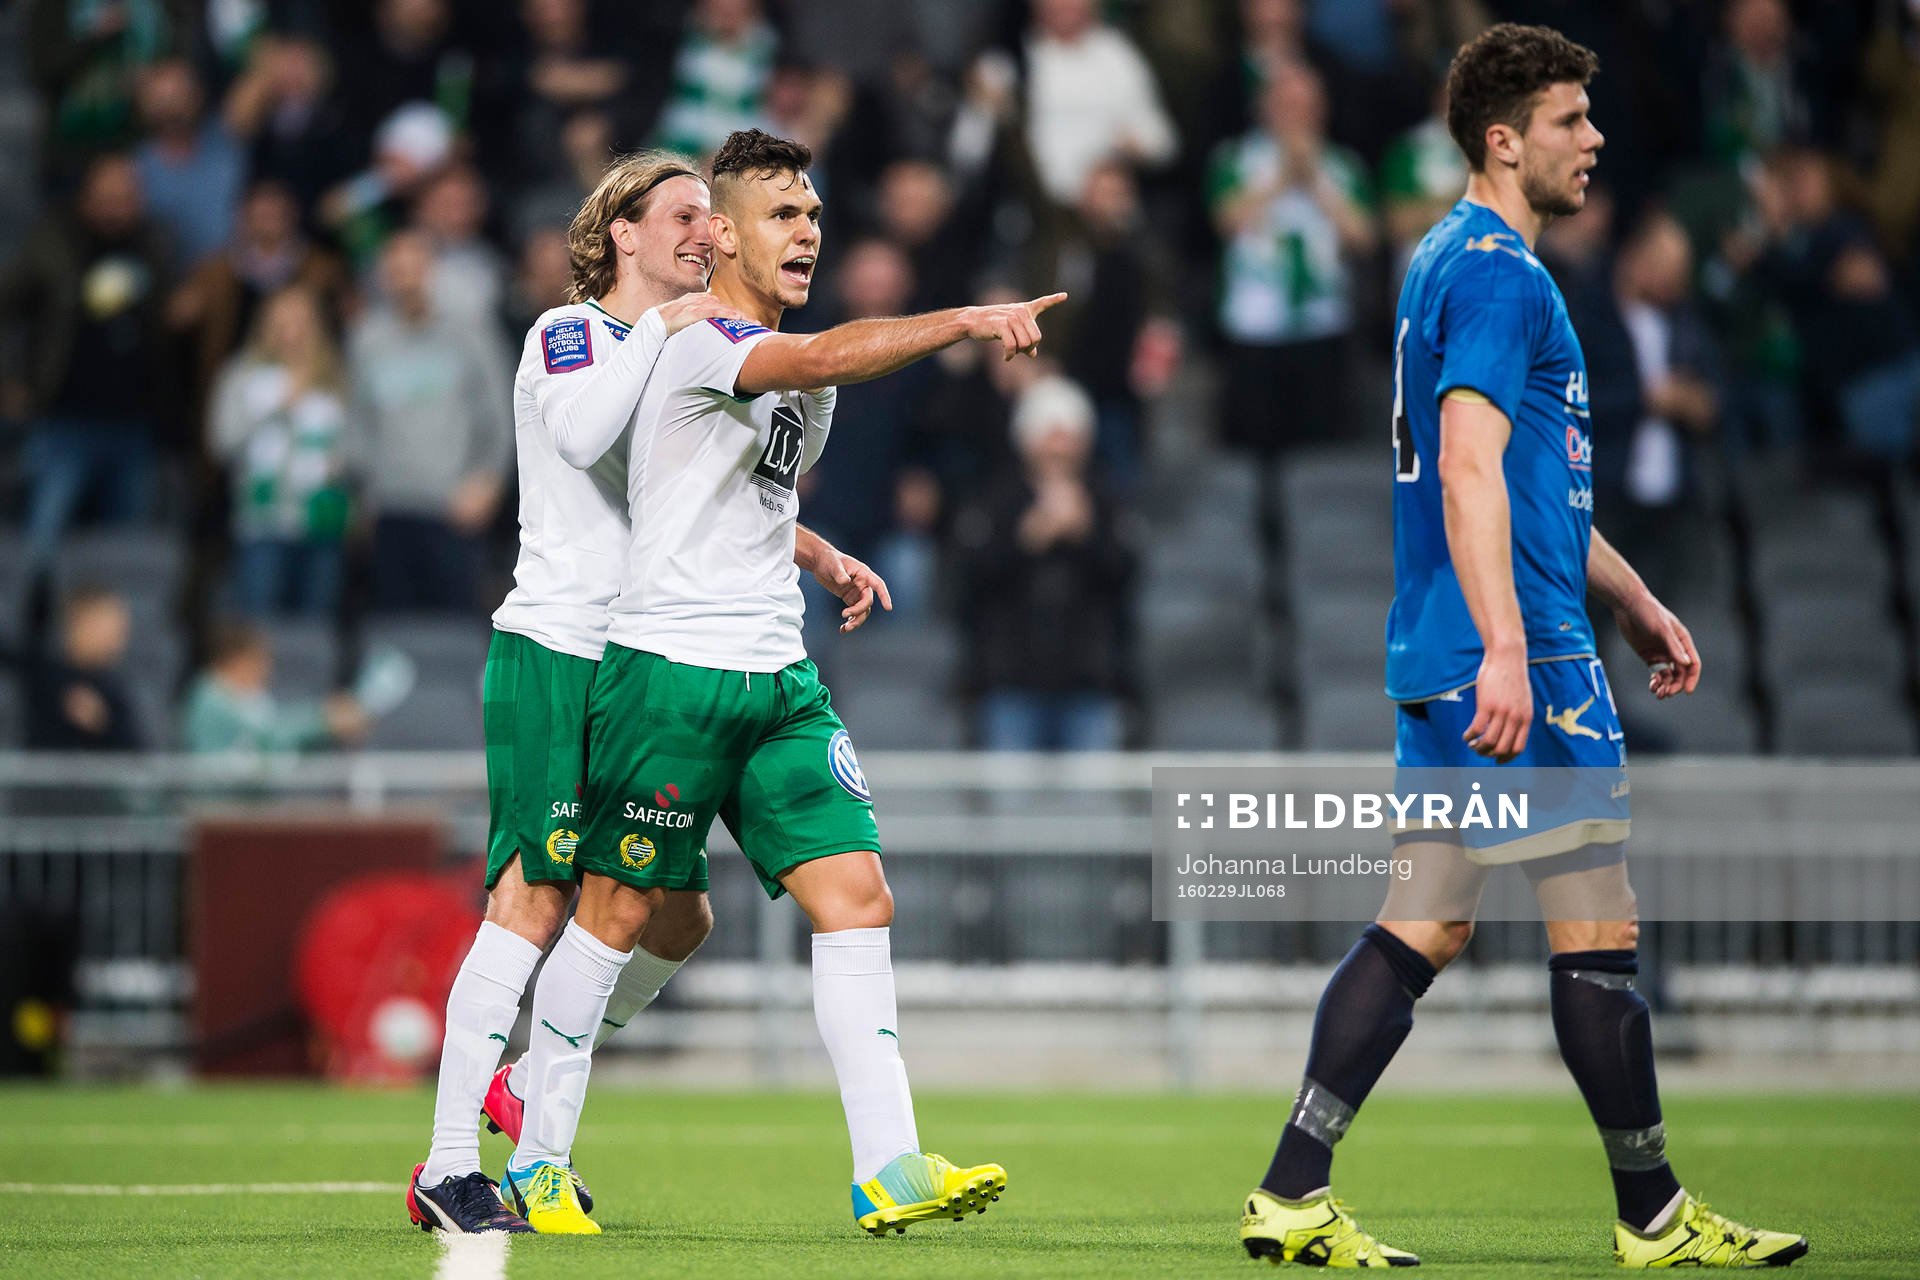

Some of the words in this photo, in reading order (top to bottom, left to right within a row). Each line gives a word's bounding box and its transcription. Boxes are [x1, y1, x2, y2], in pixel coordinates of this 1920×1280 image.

[548, 331, 584, 344] SVERIGES
[548, 339, 586, 351] FOTBOLLS
[555, 345, 579, 355] KLUBB
